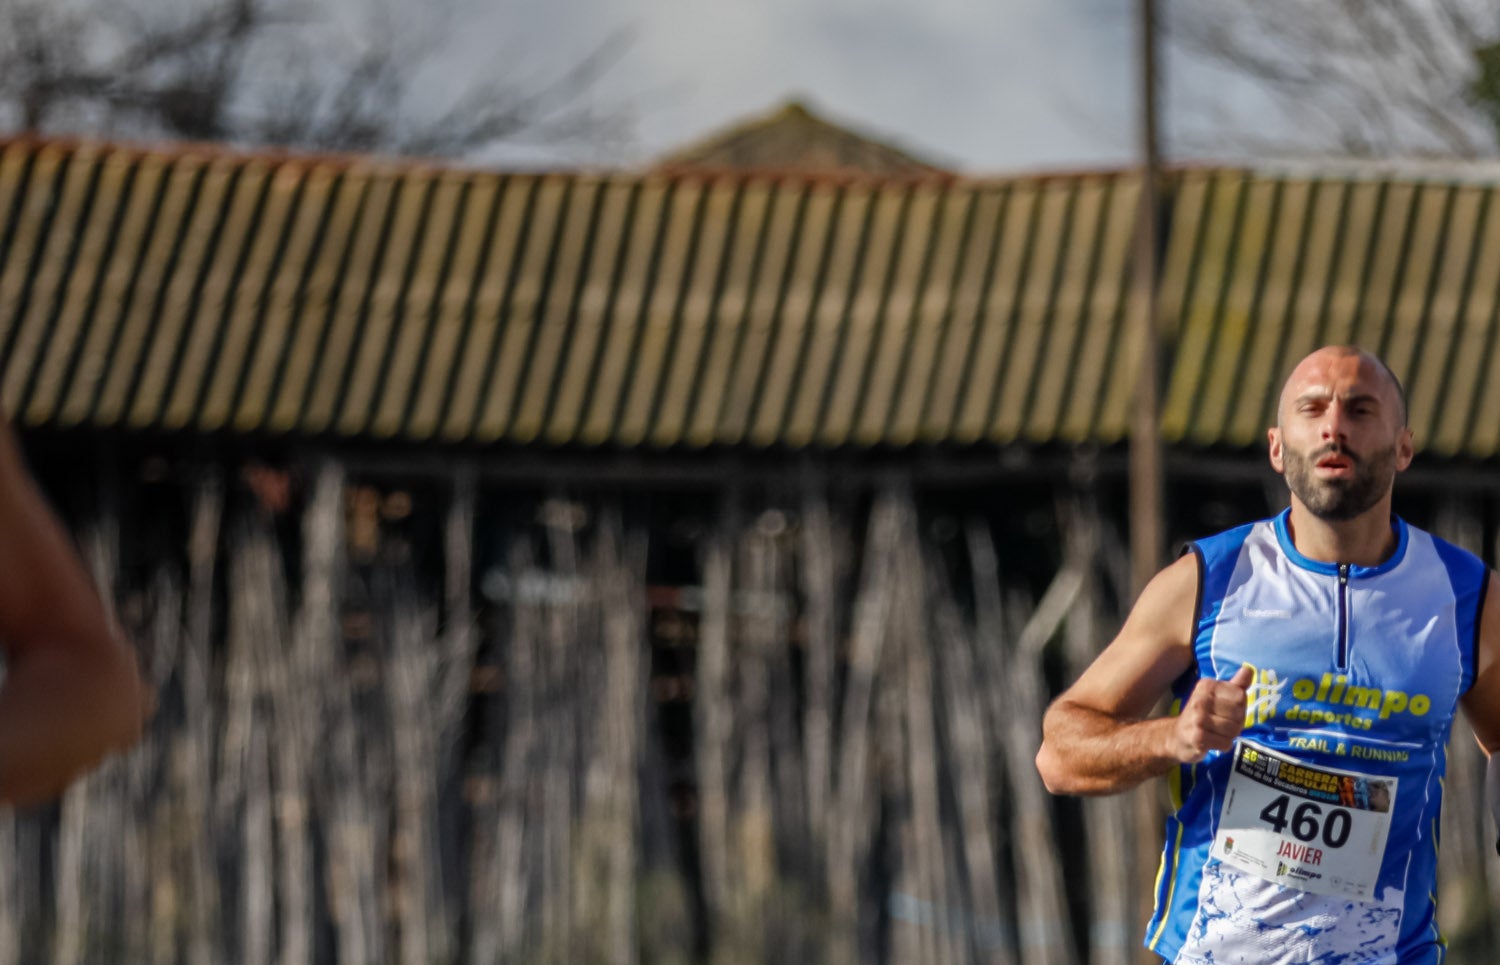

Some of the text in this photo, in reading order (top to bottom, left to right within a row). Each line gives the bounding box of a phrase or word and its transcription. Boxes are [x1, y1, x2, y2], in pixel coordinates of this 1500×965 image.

[1292, 672, 1431, 720] olimpo
[1285, 704, 1373, 730] deportes
[1288, 737, 1409, 762] TRAIL & RUNNING
[1278, 771, 1339, 794] POPULAR
[1280, 762, 1339, 785] CARRERA
[1259, 794, 1352, 848] 460
[1276, 839, 1323, 866] JAVIER
